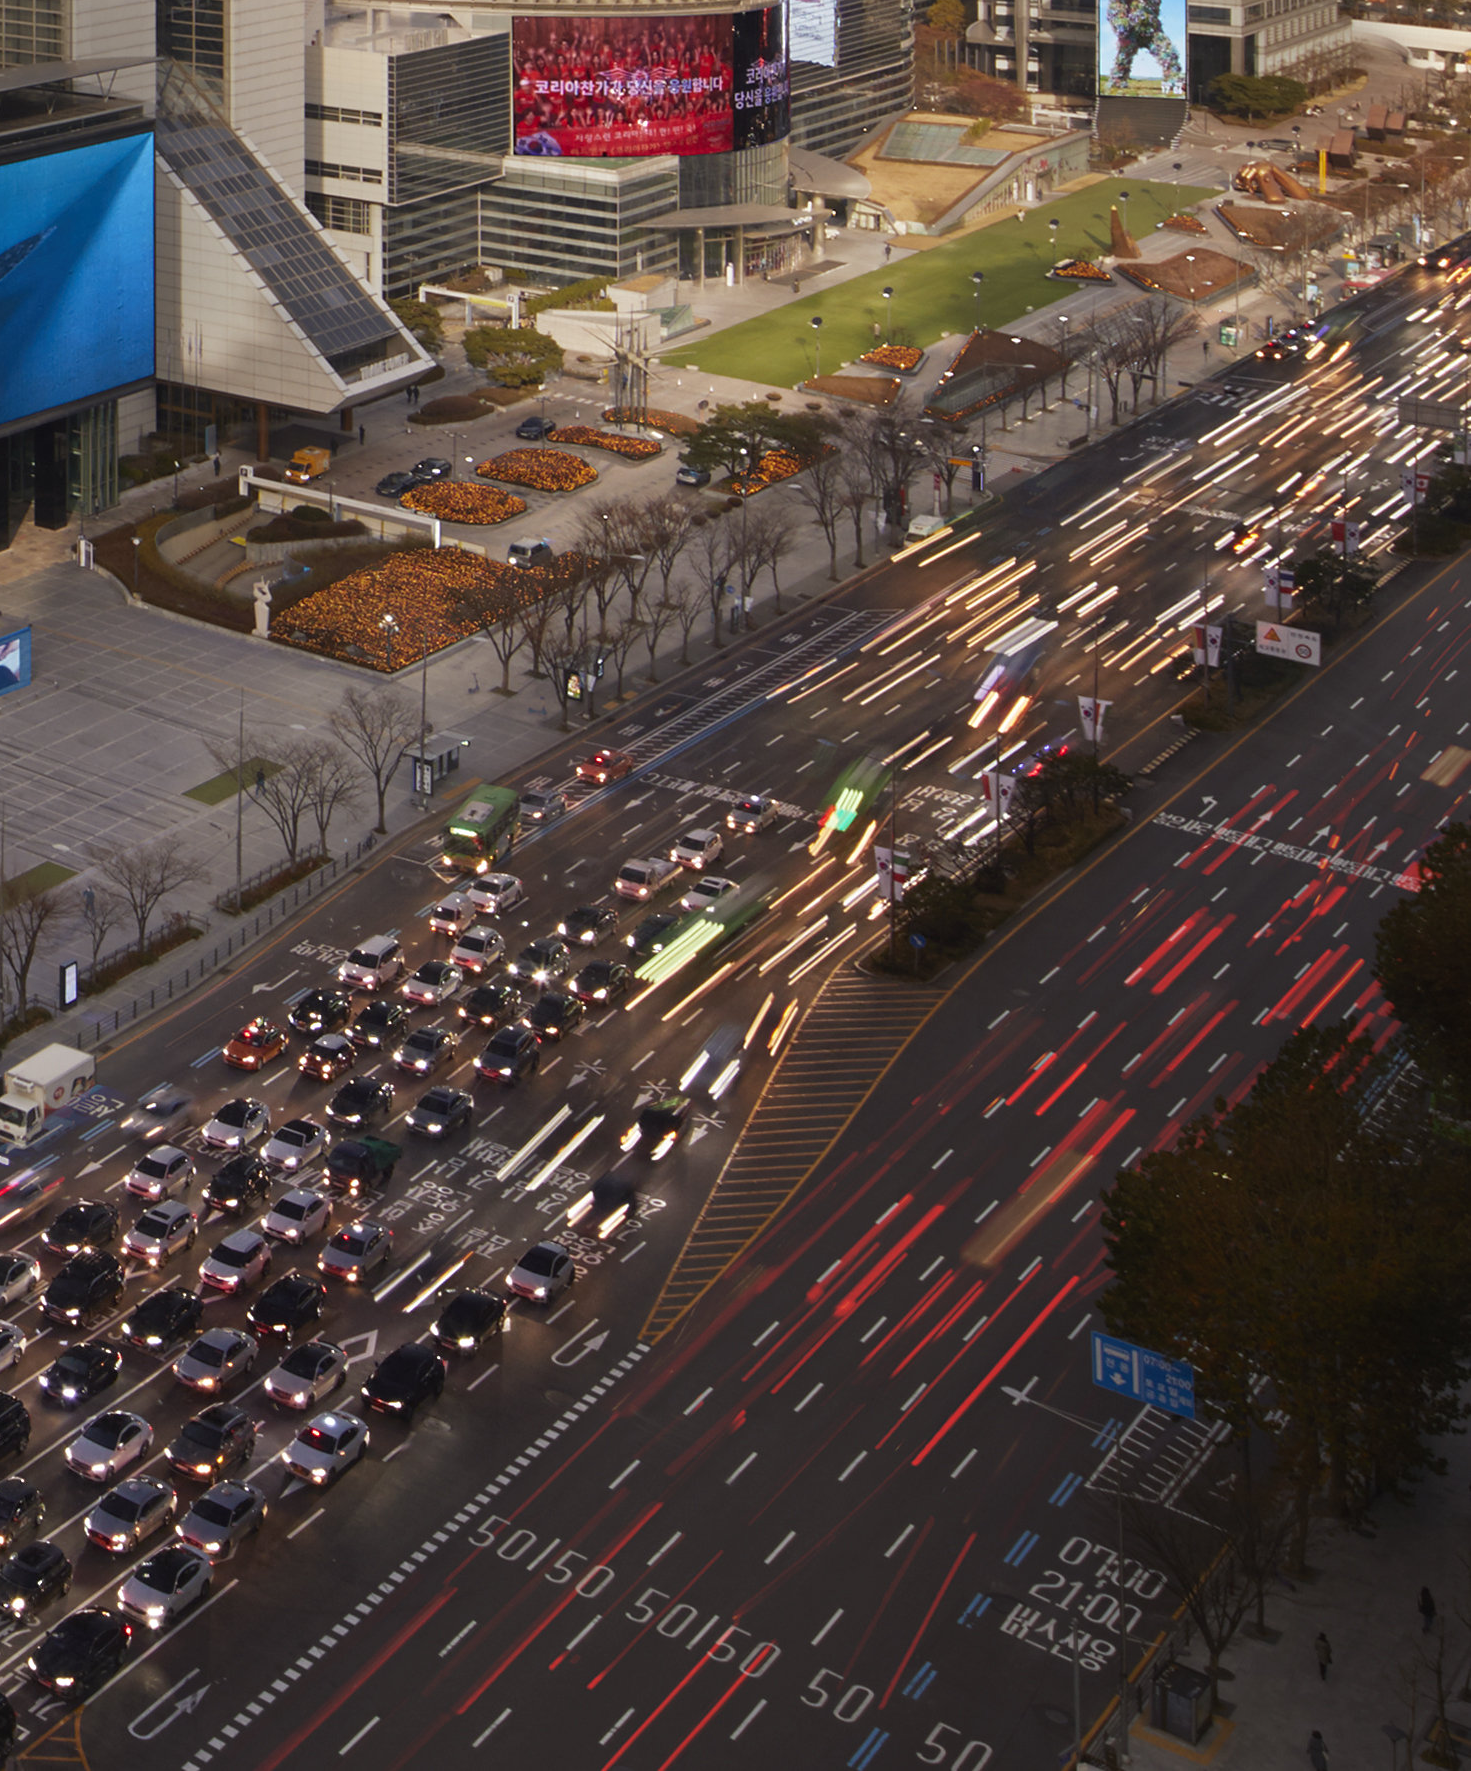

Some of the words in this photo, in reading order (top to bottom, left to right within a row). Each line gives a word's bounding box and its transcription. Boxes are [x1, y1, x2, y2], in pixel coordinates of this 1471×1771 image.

[668, 76, 723, 94] 응원합니다
[290, 938, 350, 966] 강남역
[405, 1181, 472, 1213] 운동장
[468, 1514, 537, 1564] 50
[545, 1548, 616, 1598] 50
[626, 1587, 697, 1639] 50
[708, 1625, 781, 1679] 50
[1028, 1570, 1143, 1635] 21:00
[1000, 1603, 1116, 1672] 버스전용
[800, 1667, 874, 1722] 50
[915, 1720, 994, 1771] 50
